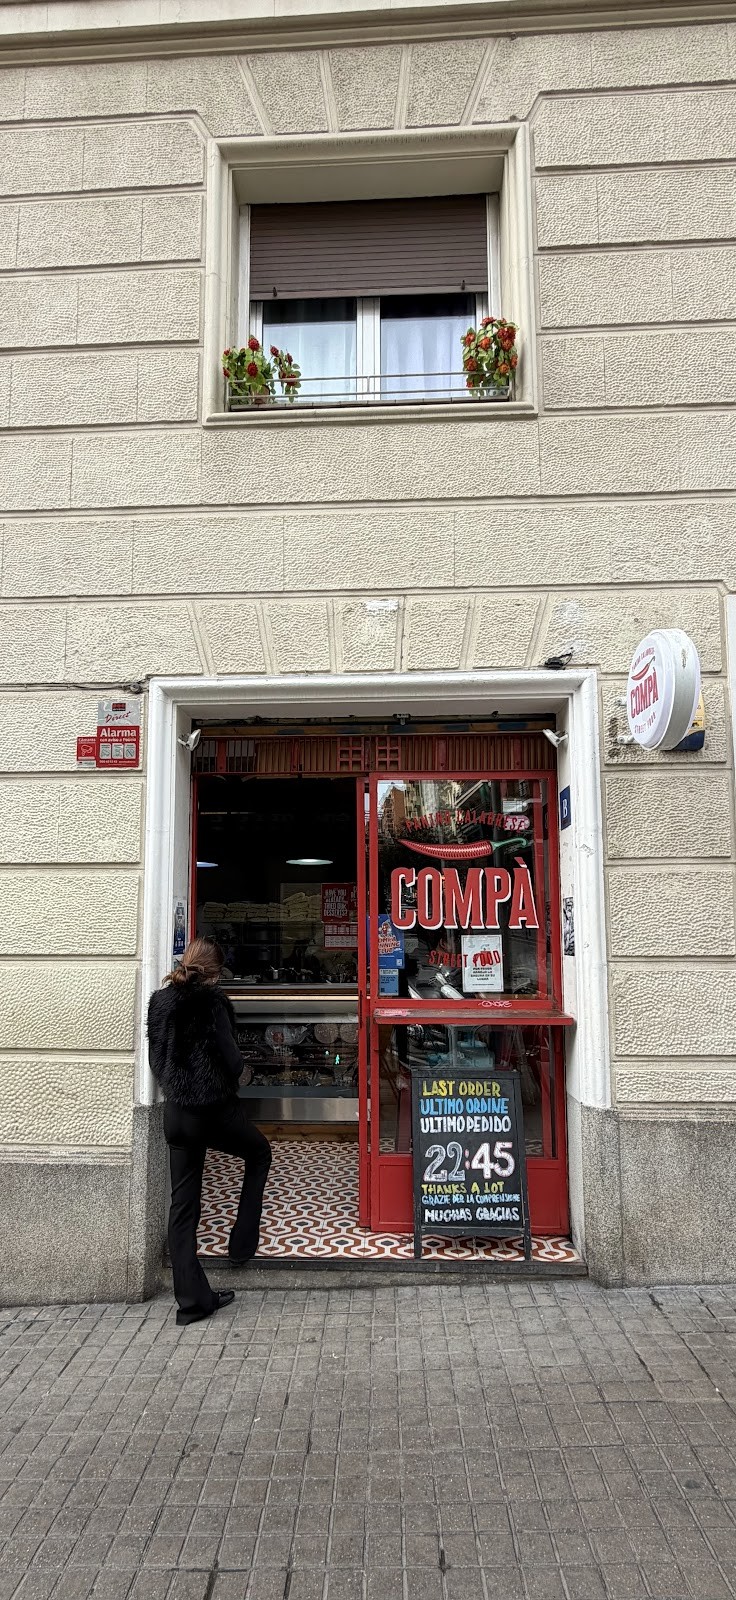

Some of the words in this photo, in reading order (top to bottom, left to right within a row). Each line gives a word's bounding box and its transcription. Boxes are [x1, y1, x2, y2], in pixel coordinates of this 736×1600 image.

[630, 666, 659, 718] COMPÀ
[100, 727, 137, 737] Alarma
[562, 799, 568, 818] B
[405, 811, 451, 832] PANINO
[456, 810, 527, 832] CALABRESE
[391, 857, 540, 930] COMPÀ
[428, 950, 469, 969] STREET
[422, 1080, 455, 1097] LAST
[459, 1081, 501, 1097] ORDER
[420, 1098, 464, 1115] ULTIMO
[465, 1098, 509, 1114] ORDINE
[420, 1116, 465, 1133] ULTIMO
[466, 1115, 511, 1132] PEDIDO
[423, 1141, 515, 1182] 22:45
[421, 1182, 467, 1195] THANKS
[471, 1181, 480, 1194] A
[484, 1181, 504, 1193] LOT
[421, 1194, 451, 1206] GRAZIE
[466, 1194, 475, 1204] LA
[424, 1208, 472, 1222] MUCHAS
[475, 1206, 520, 1221] GRACIAS
